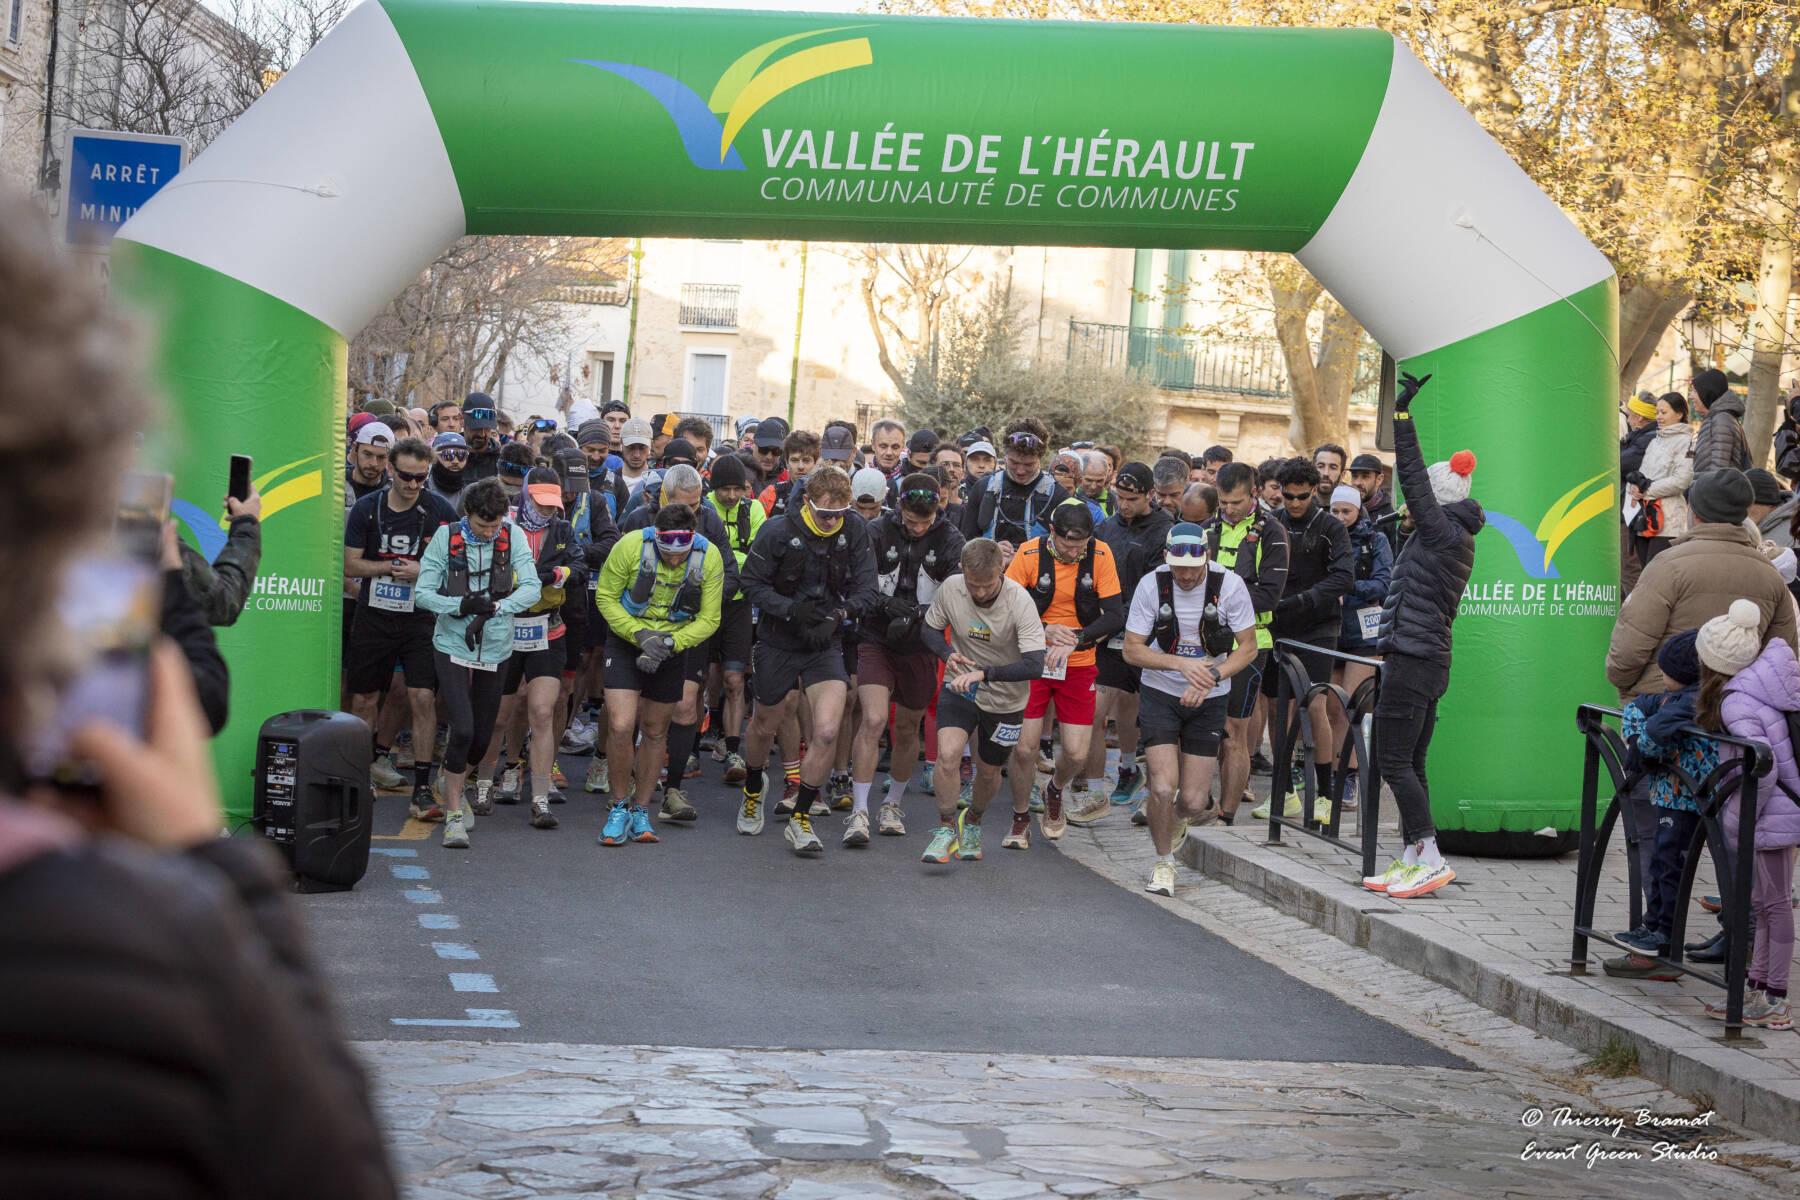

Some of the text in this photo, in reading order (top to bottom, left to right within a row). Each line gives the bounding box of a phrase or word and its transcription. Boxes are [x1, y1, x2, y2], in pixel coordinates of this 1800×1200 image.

[762, 123, 1255, 181] VALLÉE DE L'HÉRAULT
[90, 163, 160, 185] ARRÊT
[759, 176, 1240, 212] COMMUNAUTÉ DE COMMUNES
[80, 203, 138, 223] MINU
[253, 573, 326, 597] HÉRAULT
[376, 584, 402, 598] 2118
[1460, 580, 1617, 602] ALLÉE DE L'HÉRAULT
[256, 597, 323, 612] COMMUNES
[1459, 601, 1617, 617] OMMUNAUTÉ DE COMMUNES
[514, 628, 534, 638] 151
[1175, 646, 1197, 656] 242
